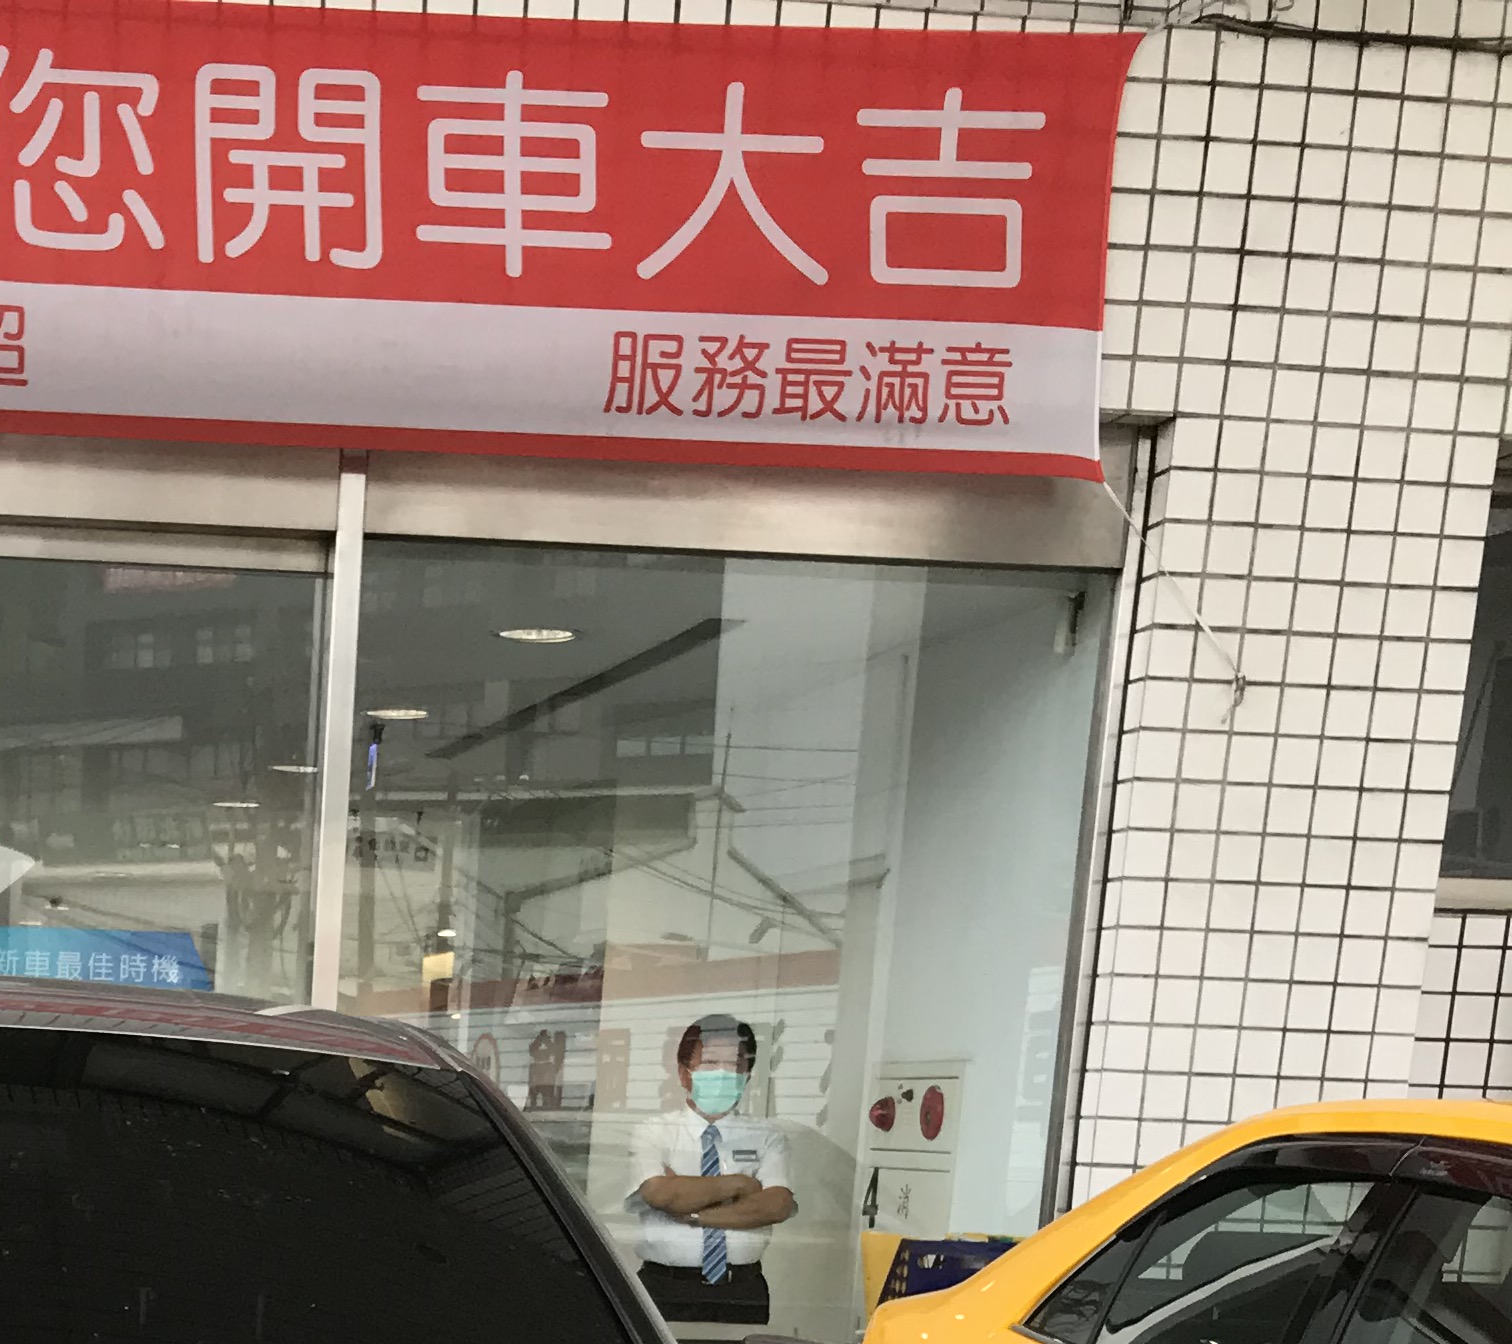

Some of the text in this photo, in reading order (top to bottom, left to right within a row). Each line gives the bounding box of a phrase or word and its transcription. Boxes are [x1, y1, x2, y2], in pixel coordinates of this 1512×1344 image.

[602, 330, 1015, 427] 服務最滿意
